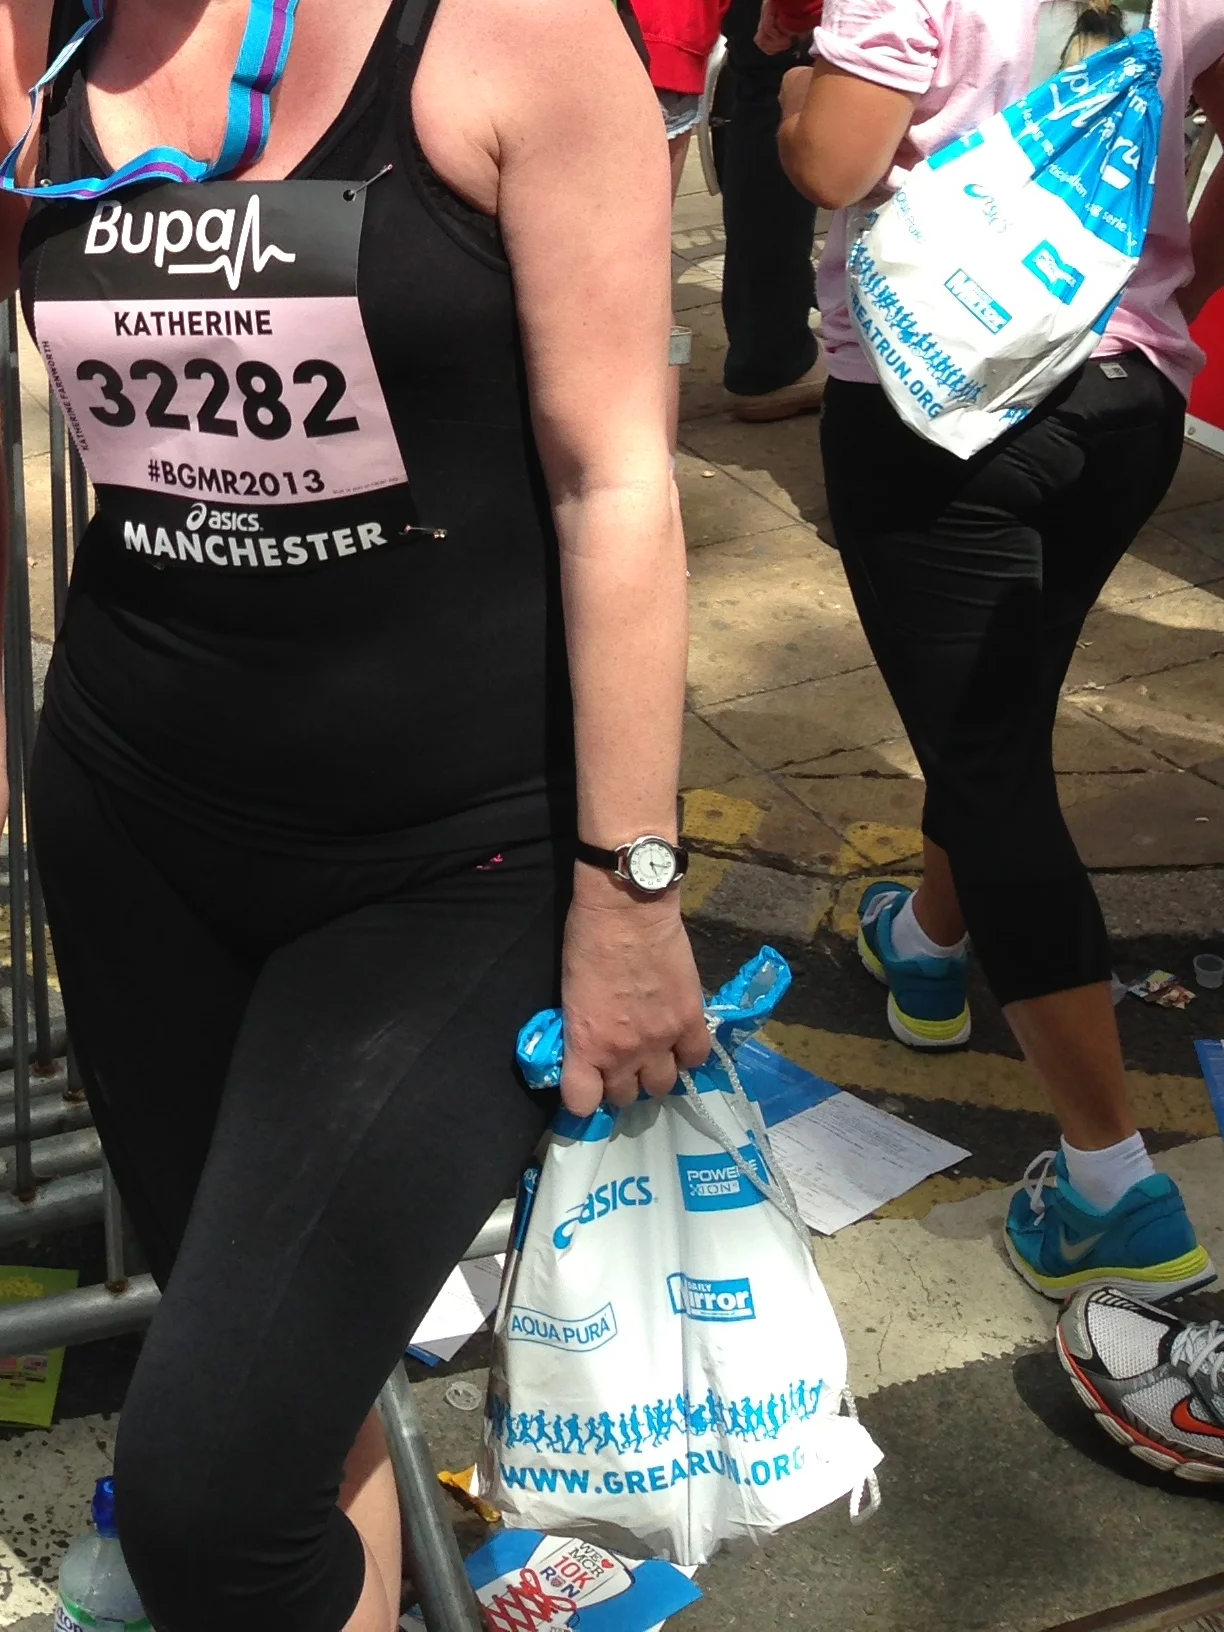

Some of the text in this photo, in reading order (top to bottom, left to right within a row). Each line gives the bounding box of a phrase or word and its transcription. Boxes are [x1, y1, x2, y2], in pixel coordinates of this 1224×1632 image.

[85, 200, 236, 268] Bupa
[114, 310, 274, 337] KATHERINE
[41, 340, 90, 452] KATHERINE FARNWORTH
[76, 358, 361, 441] 32282
[147, 458, 326, 498] #BGMR2013
[124, 520, 388, 568] MANCHESTER
[684, 1289, 750, 1312] irror
[511, 1315, 611, 1344] AQUA PURA
[568, 1548, 605, 1578] MCR
[578, 1541, 603, 1564] WE
[553, 1555, 596, 1590] 10K
